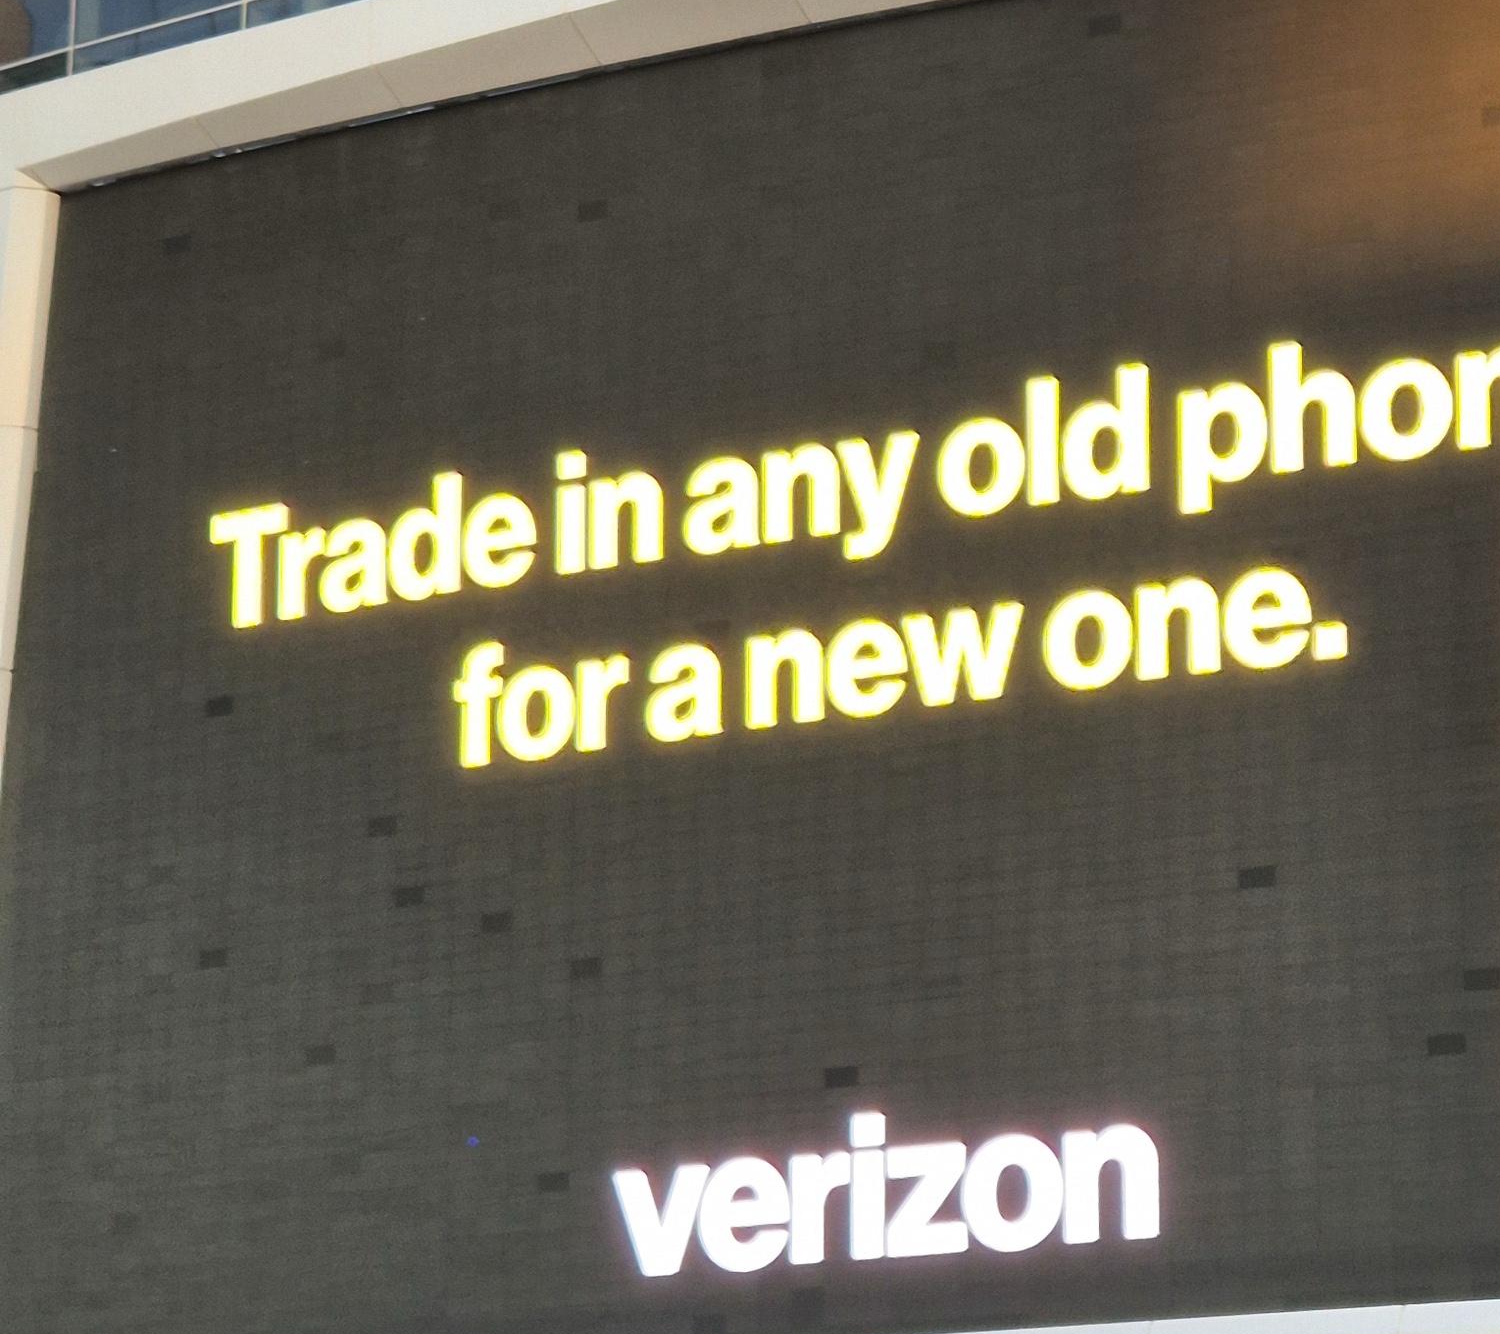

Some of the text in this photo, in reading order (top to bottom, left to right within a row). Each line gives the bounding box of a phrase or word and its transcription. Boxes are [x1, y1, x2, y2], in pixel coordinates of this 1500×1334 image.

[209, 470, 537, 630] Trade
[553, 450, 665, 575] in
[683, 430, 921, 561] any
[937, 362, 1151, 518] old
[453, 566, 1349, 769] for a new one.
[612, 1111, 1160, 1278] verizon
